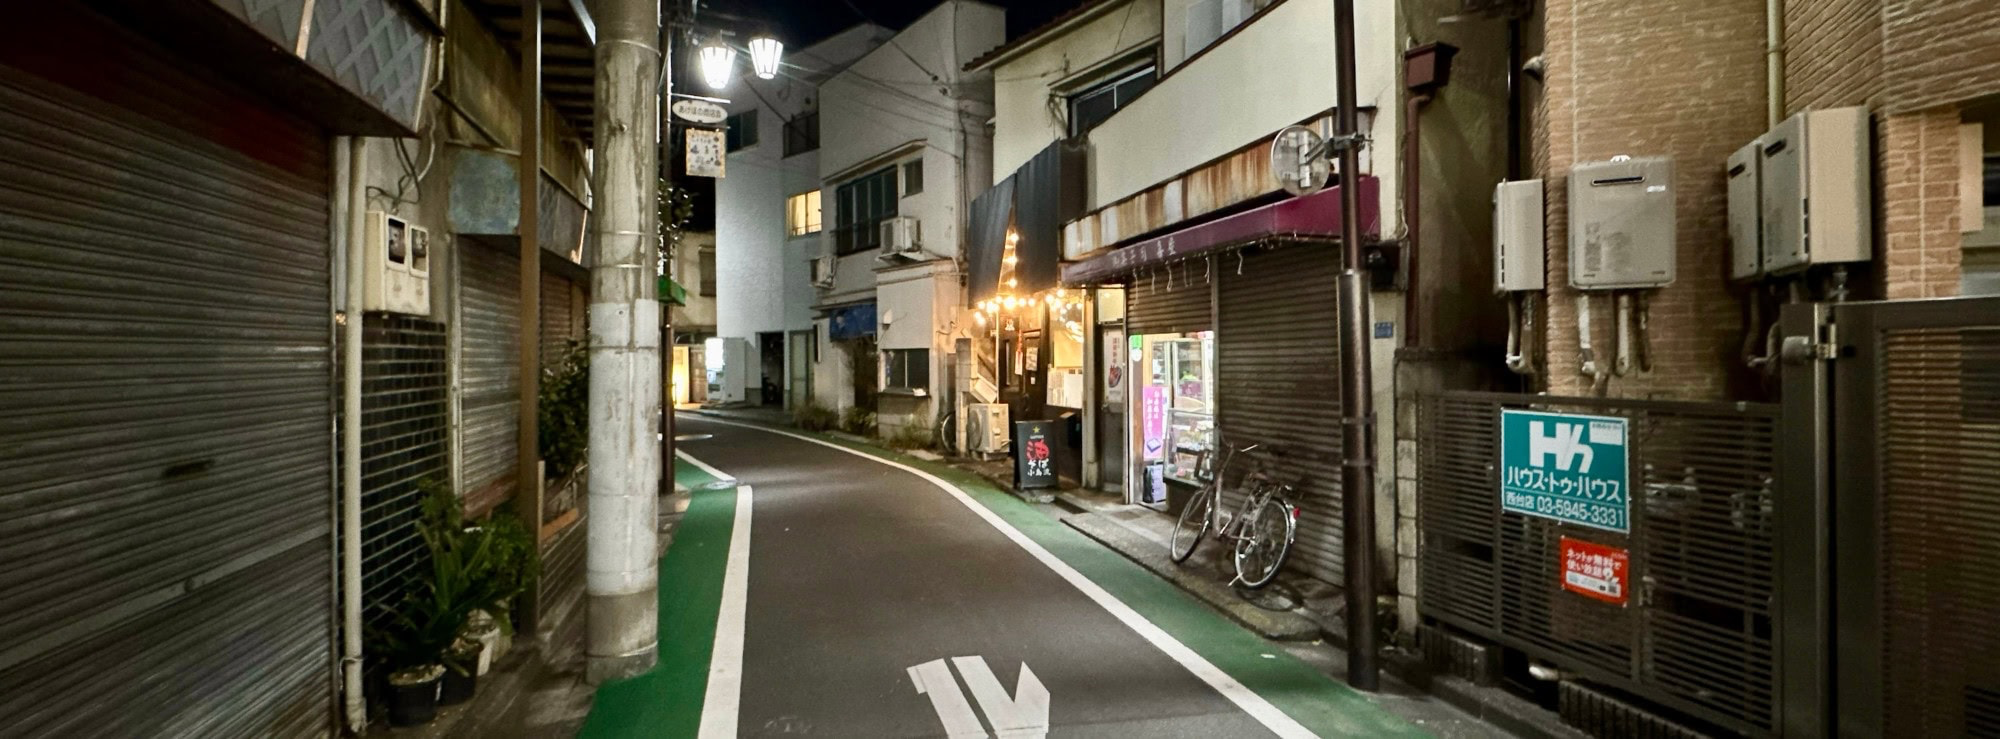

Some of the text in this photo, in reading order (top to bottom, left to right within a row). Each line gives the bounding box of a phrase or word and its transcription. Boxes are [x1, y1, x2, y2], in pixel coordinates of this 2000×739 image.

[1027, 458, 1050, 469] そば
[1507, 466, 1622, 503] ハウス・トゥ・ハウス
[1505, 491, 1623, 527] 西台店 03-5945-3331
